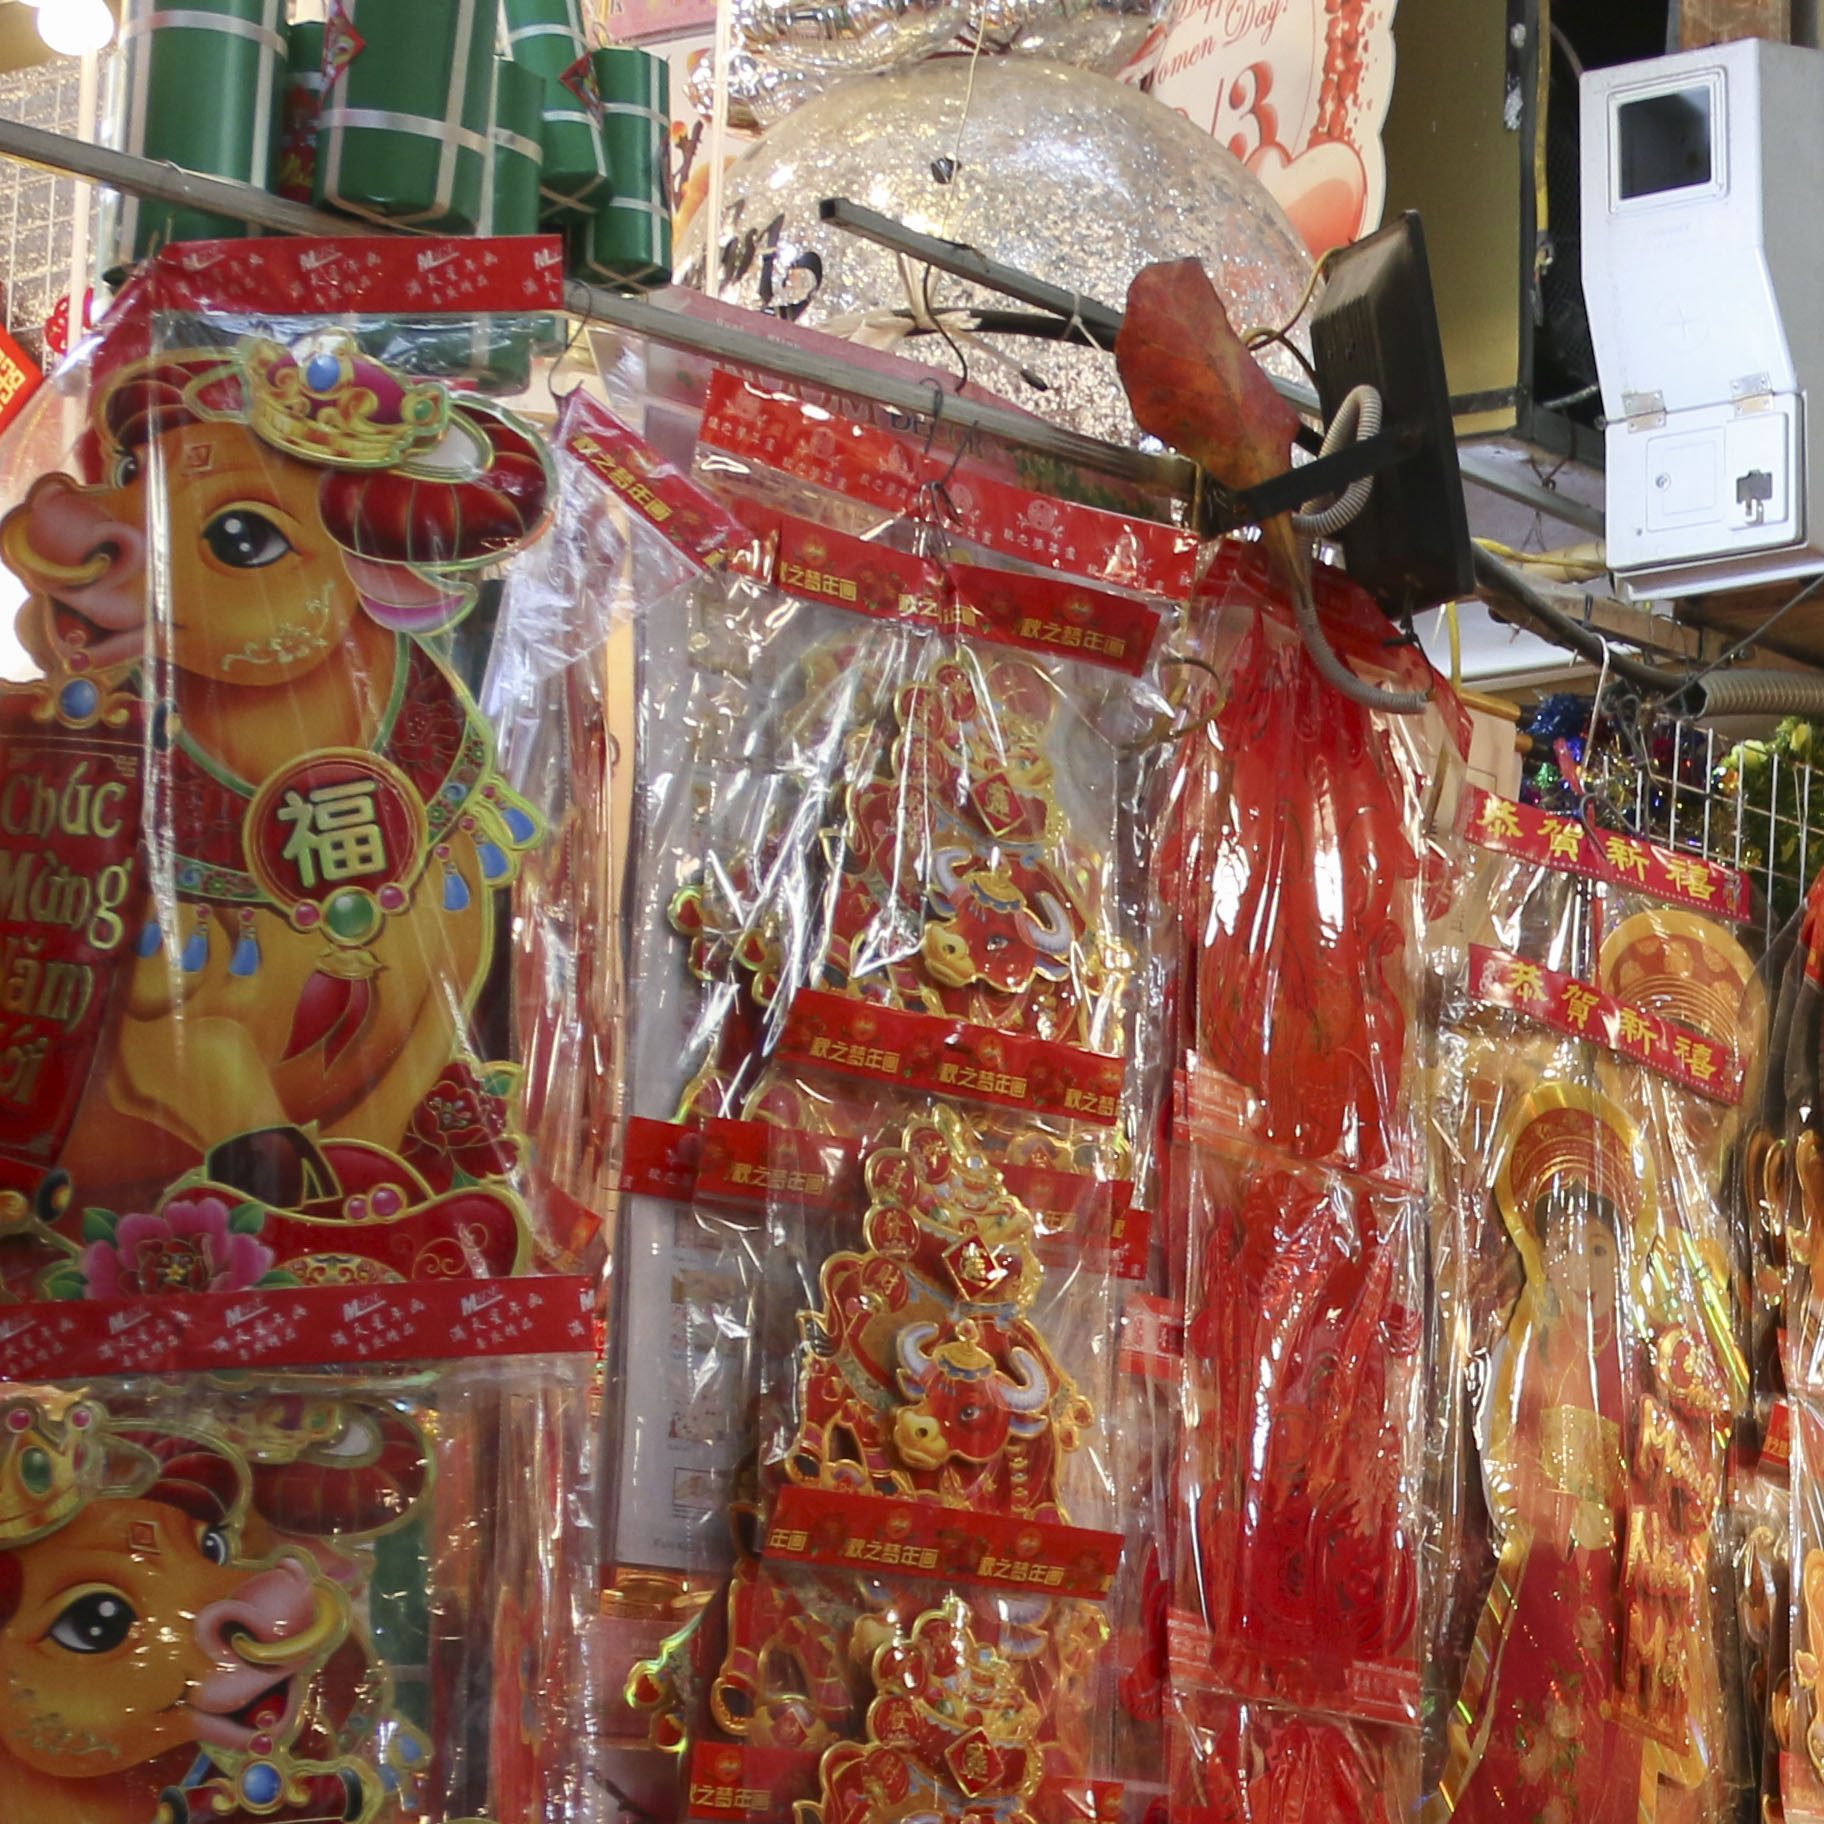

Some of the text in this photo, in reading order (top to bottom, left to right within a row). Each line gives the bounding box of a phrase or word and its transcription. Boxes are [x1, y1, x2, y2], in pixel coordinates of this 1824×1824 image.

[1125, 35, 1216, 88] omen
[2, 760, 127, 840] Chúc
[277, 779, 388, 884] 福
[1477, 799, 1717, 900] 恭賀新禧
[0, 934, 95, 1036] ăm
[1505, 959, 1719, 1082] 恭賀新禧
